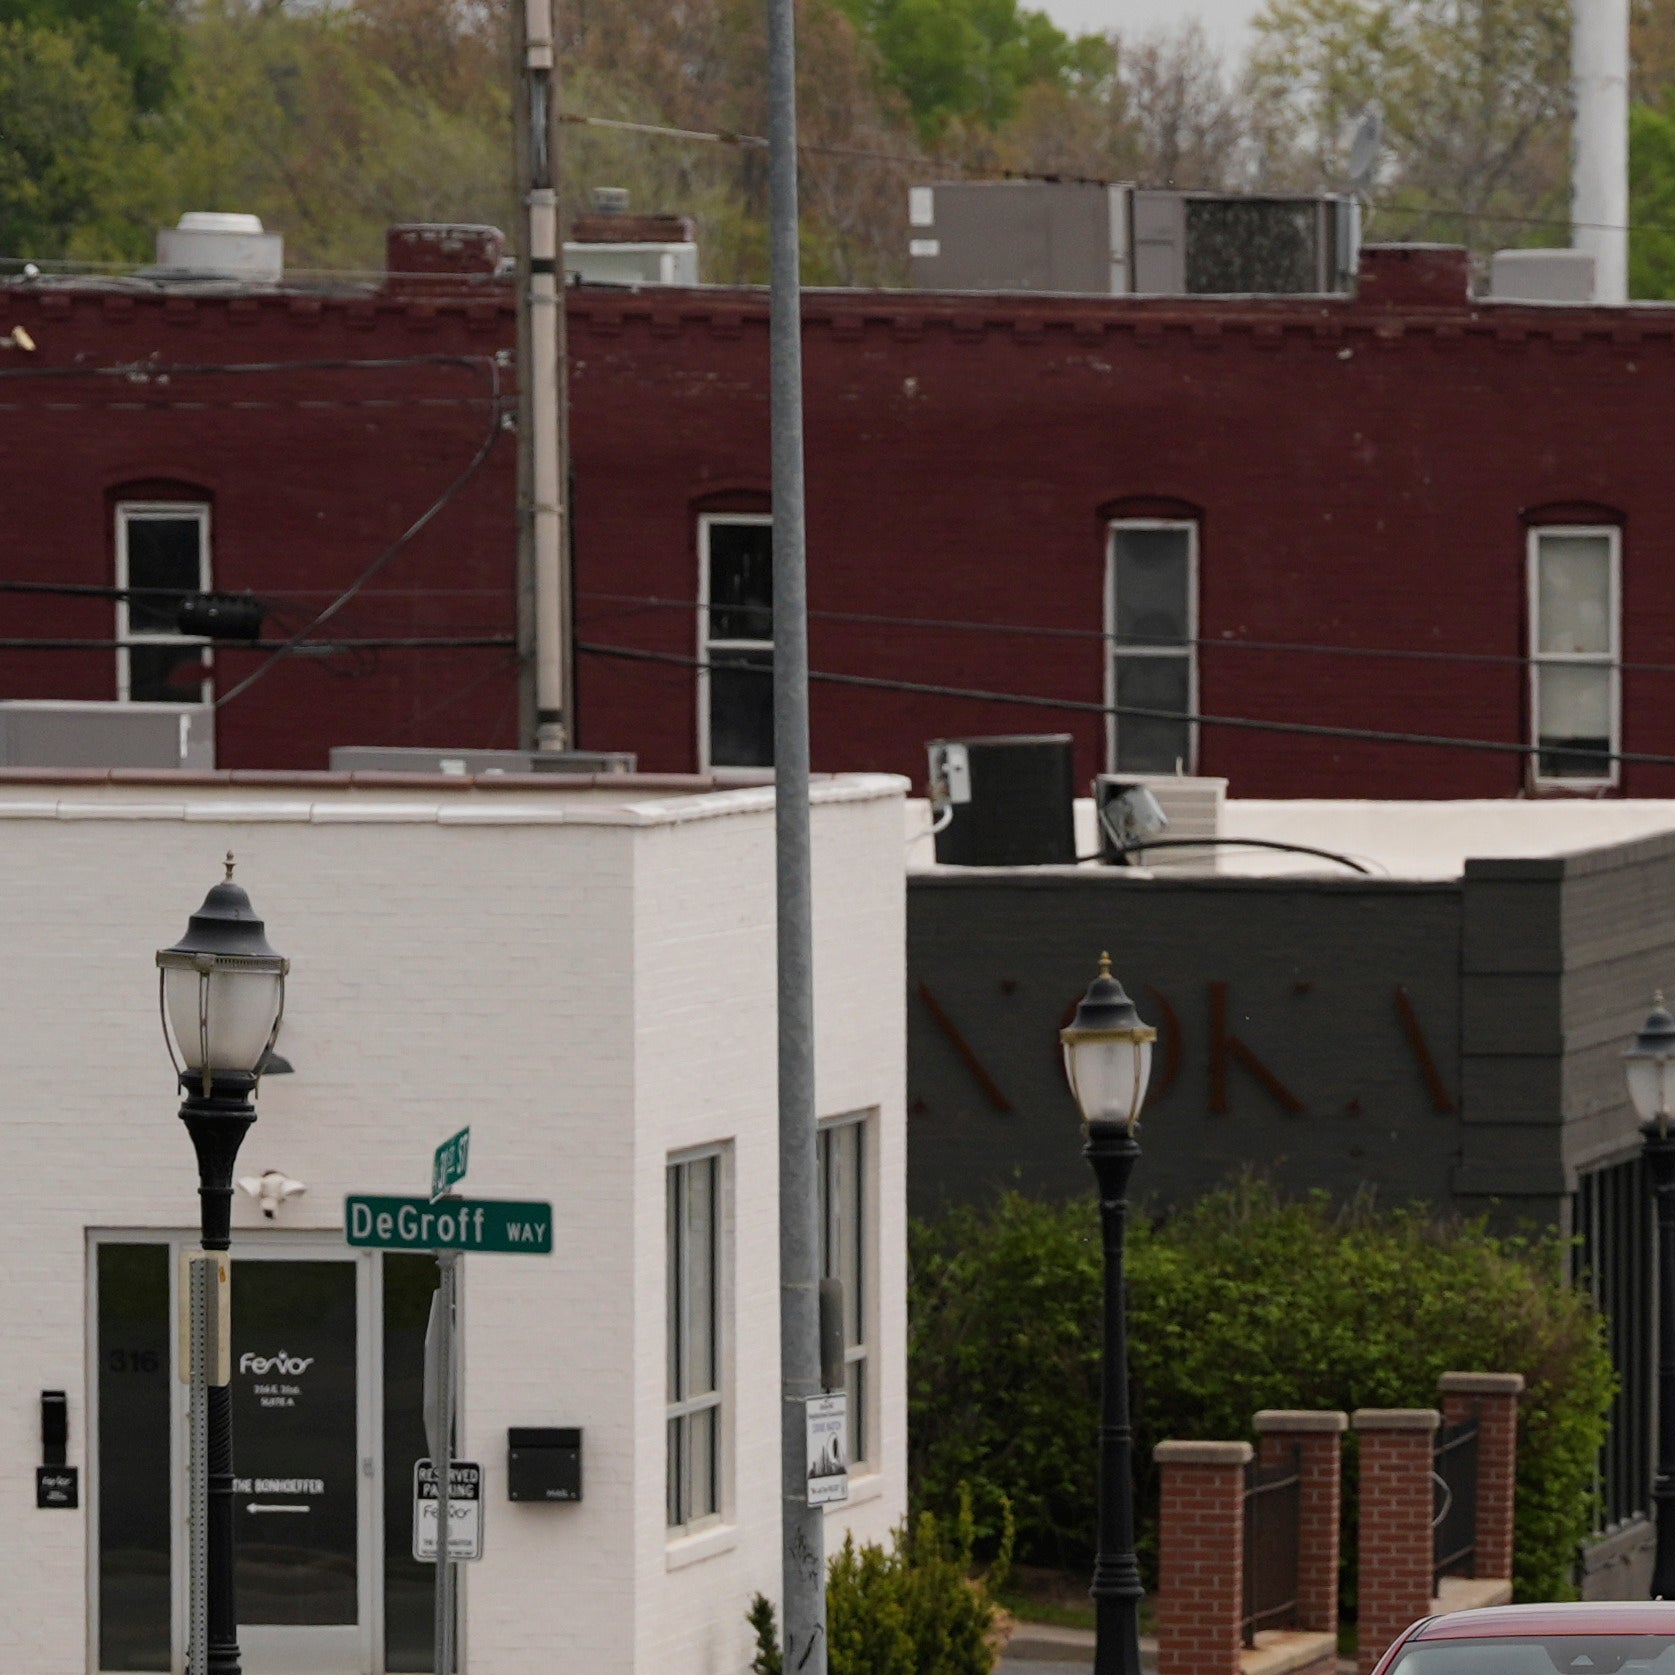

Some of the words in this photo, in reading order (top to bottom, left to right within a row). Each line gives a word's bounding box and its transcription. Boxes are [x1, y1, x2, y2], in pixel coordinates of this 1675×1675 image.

[351, 1202, 485, 1243] DeGroff
[506, 1222, 547, 1243] WAY
[239, 1350, 315, 1375] Fervor
